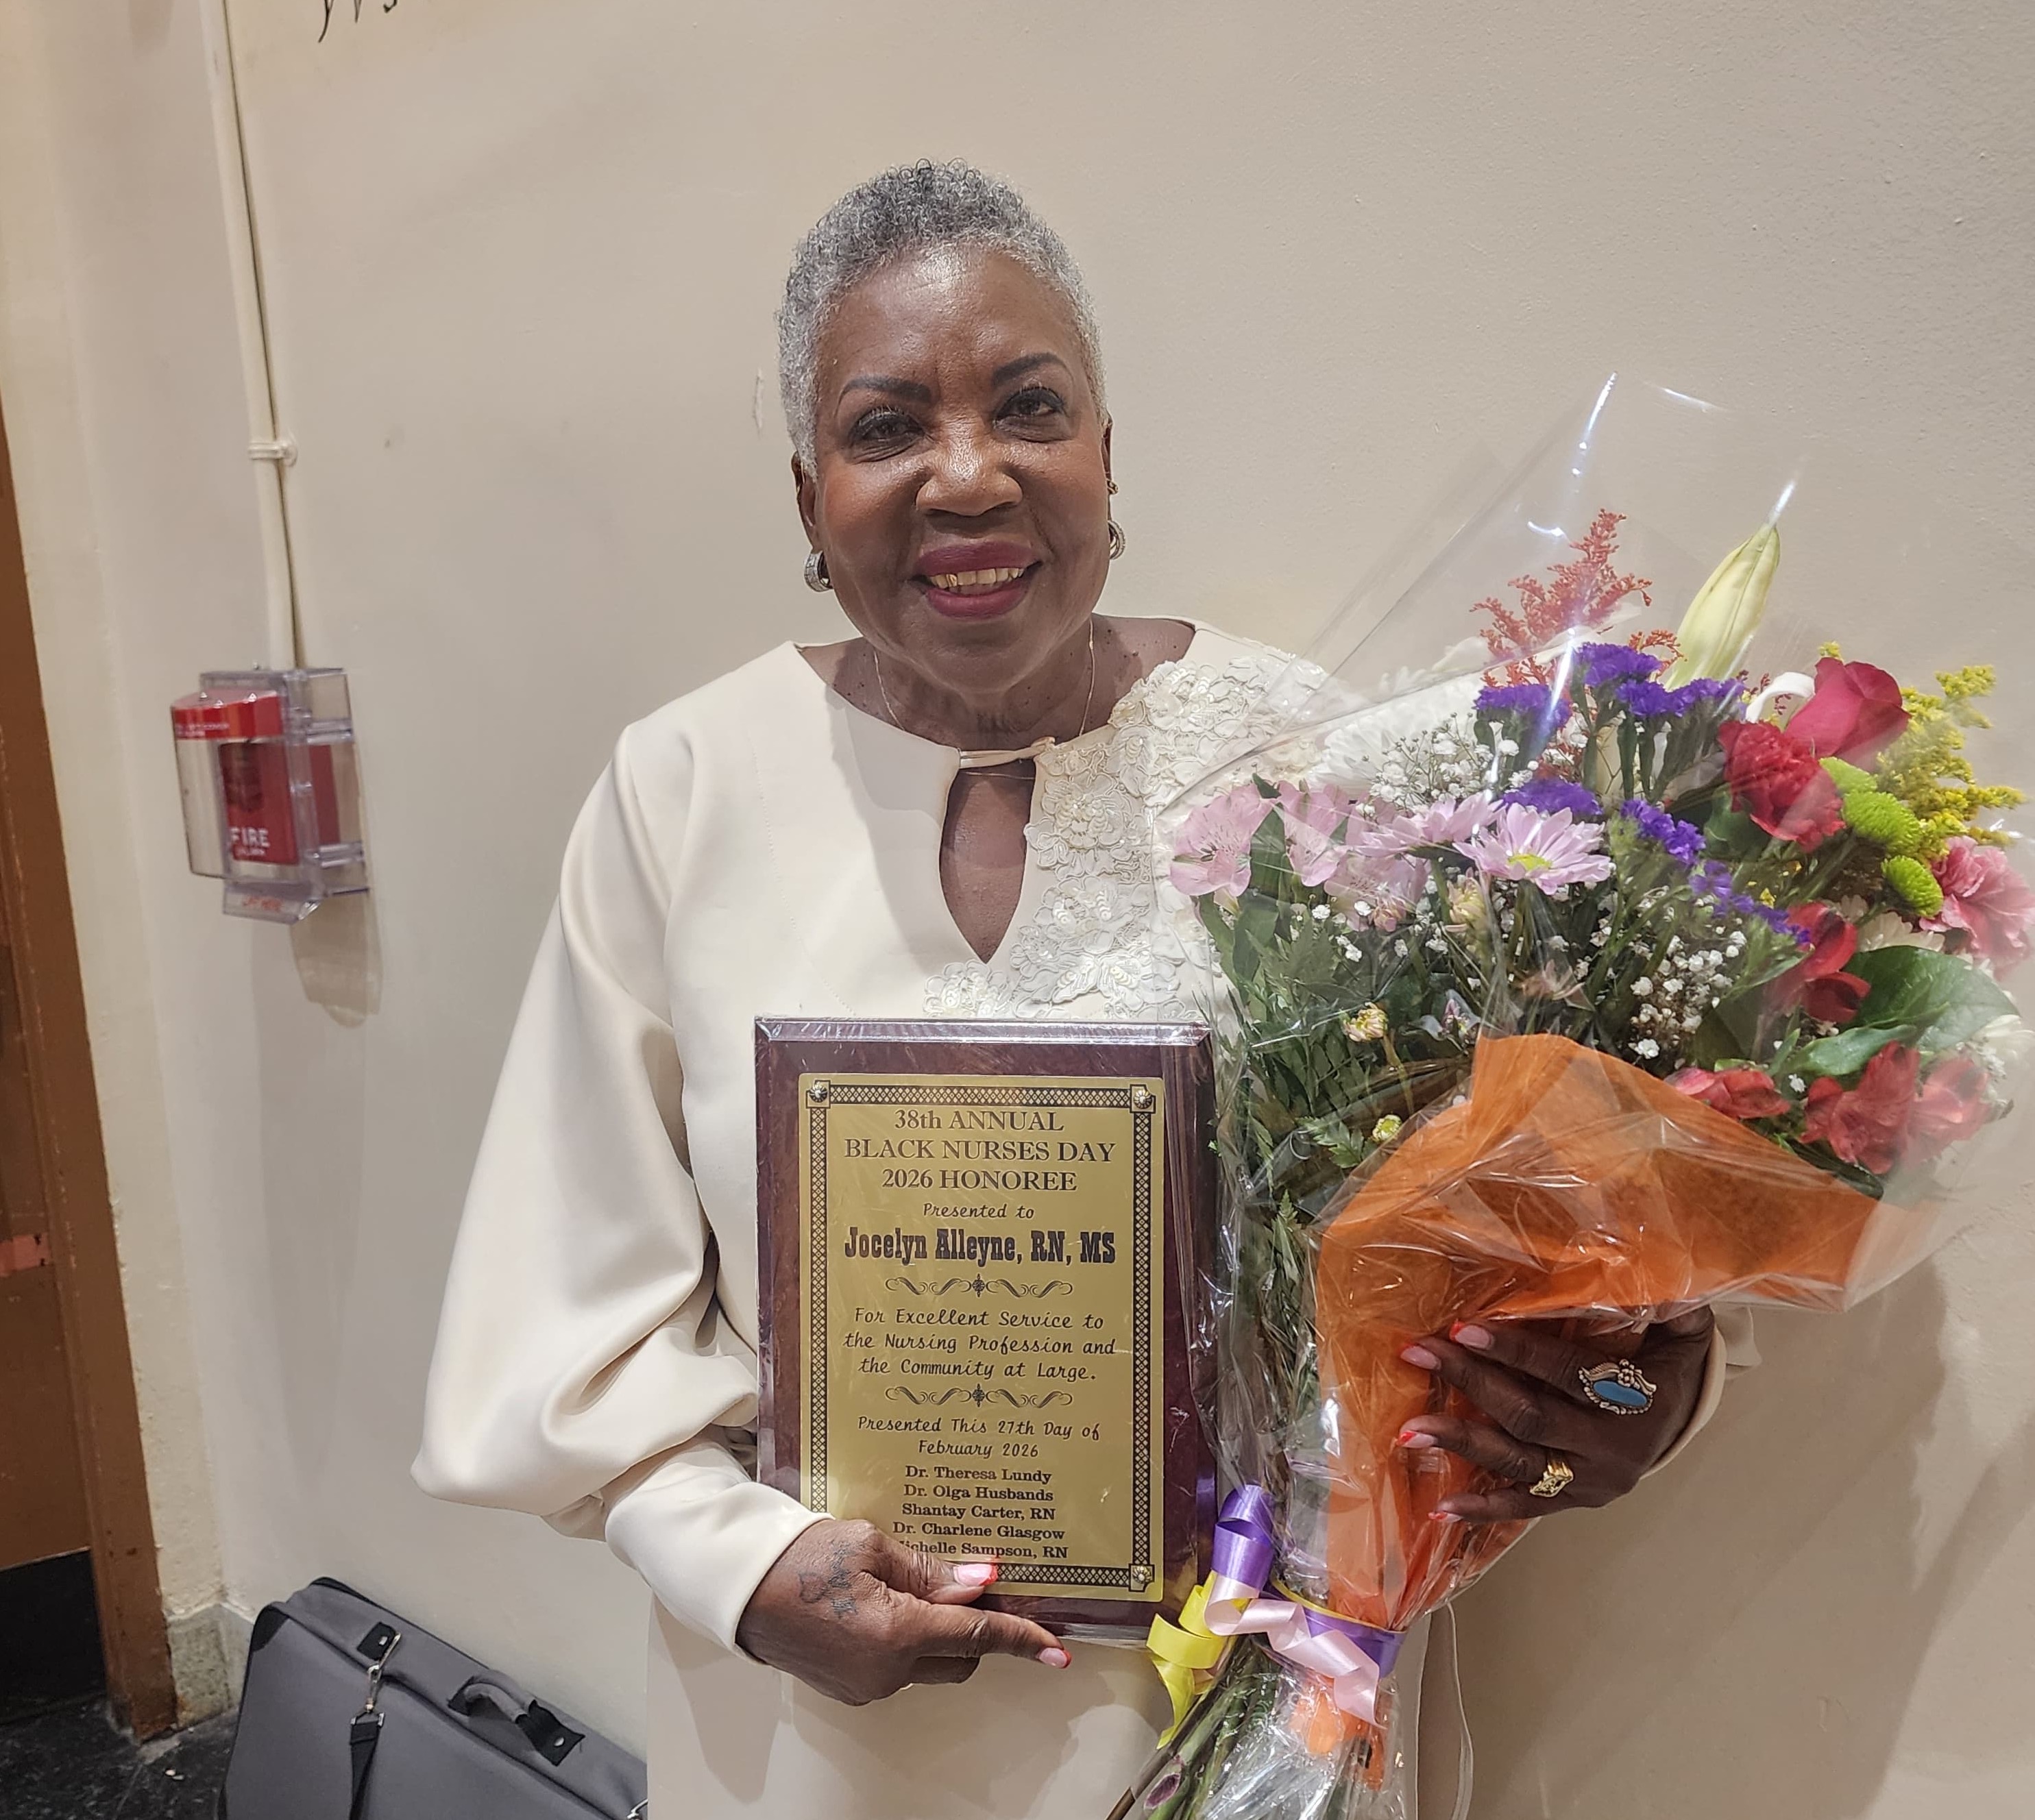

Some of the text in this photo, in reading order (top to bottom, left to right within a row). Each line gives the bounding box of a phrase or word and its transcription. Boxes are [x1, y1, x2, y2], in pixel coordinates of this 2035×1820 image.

[230, 827, 270, 848] FIRE
[894, 1110, 1064, 1132] 38th ANNUAL
[844, 1139, 1116, 1162] BLACK NURSES DAY
[881, 1168, 1077, 1192] 2026 HONOREE
[923, 1203, 1034, 1219] Presented to
[845, 1227, 1116, 1267] Jocelyn Alleyne, RN, MS
[855, 1307, 1104, 1329] For Excellent Service to
[843, 1333, 1116, 1355] the Nursing Profession and
[858, 1357, 1096, 1382] the Community at Large.
[858, 1416, 1100, 1440] Presented This 27th Day of
[918, 1440, 1038, 1459] February 2026
[905, 1466, 1052, 1484] Dr. Theresa Lundy
[904, 1484, 1053, 1501] Dr. Olga Husbands
[902, 1503, 1056, 1521] Shantay Carter, RN
[893, 1521, 1064, 1541] Dr. Charlene Glasgow
[899, 1540, 1069, 1560] ichelle Sampson, RN
